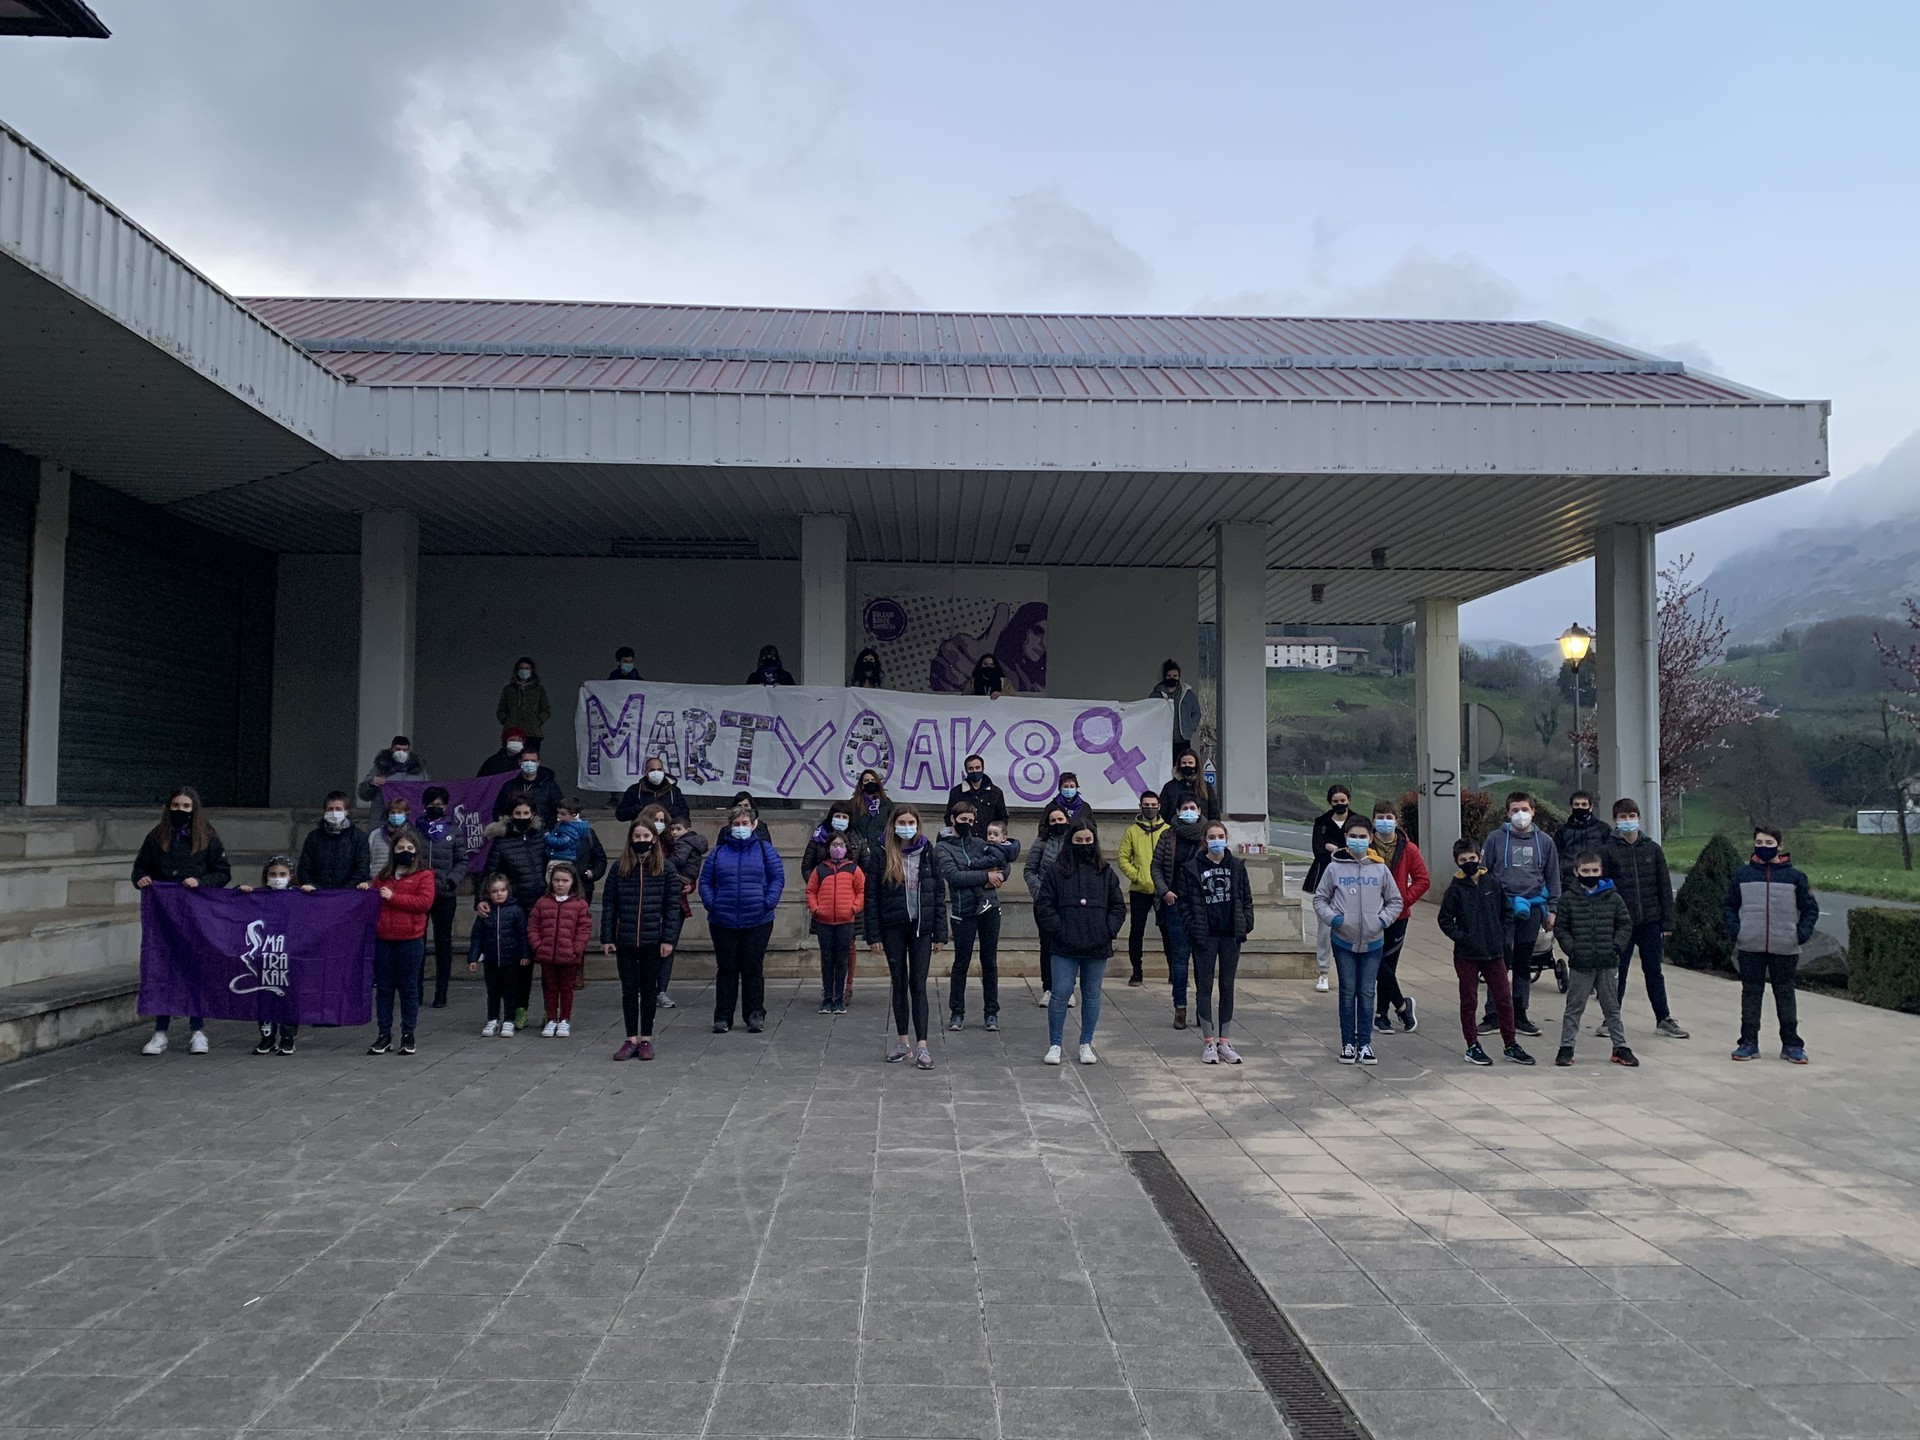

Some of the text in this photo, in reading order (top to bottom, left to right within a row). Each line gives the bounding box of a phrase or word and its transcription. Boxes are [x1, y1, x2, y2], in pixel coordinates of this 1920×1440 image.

[586, 693, 1062, 802] MARTXOAK 8
[465, 812, 480, 824] MA
[465, 823, 484, 836] TRA
[467, 836, 484, 849] KAK
[262, 934, 285, 952] MA
[261, 952, 288, 969] TRA
[262, 969, 290, 987] KAK
